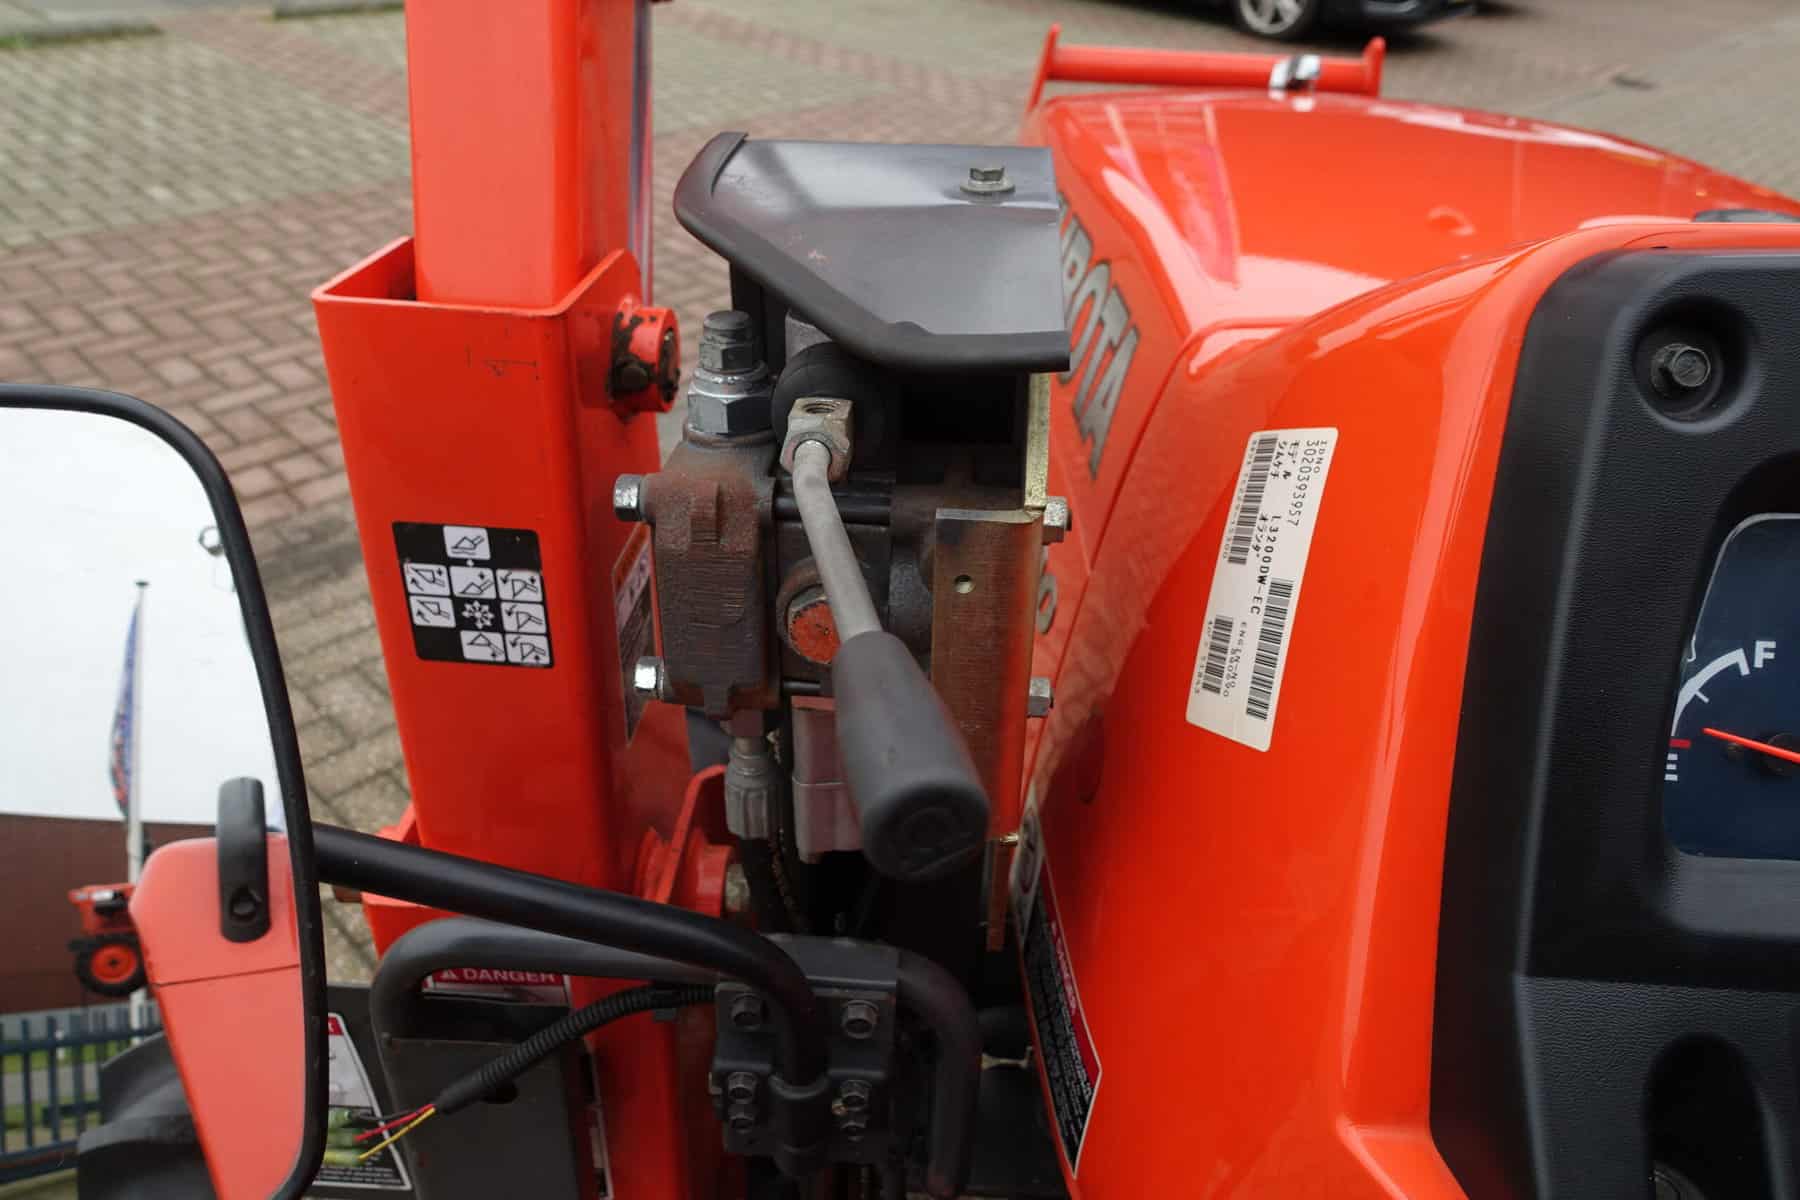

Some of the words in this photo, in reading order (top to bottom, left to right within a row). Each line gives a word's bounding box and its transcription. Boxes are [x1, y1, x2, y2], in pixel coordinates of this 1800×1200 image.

[1313, 440, 1327, 473] IDNO
[1287, 440, 1319, 526] 3020393957
[1250, 515, 1281, 615] L3200DW-EC
[1754, 640, 1776, 668] F
[462, 967, 556, 983] DANGER
